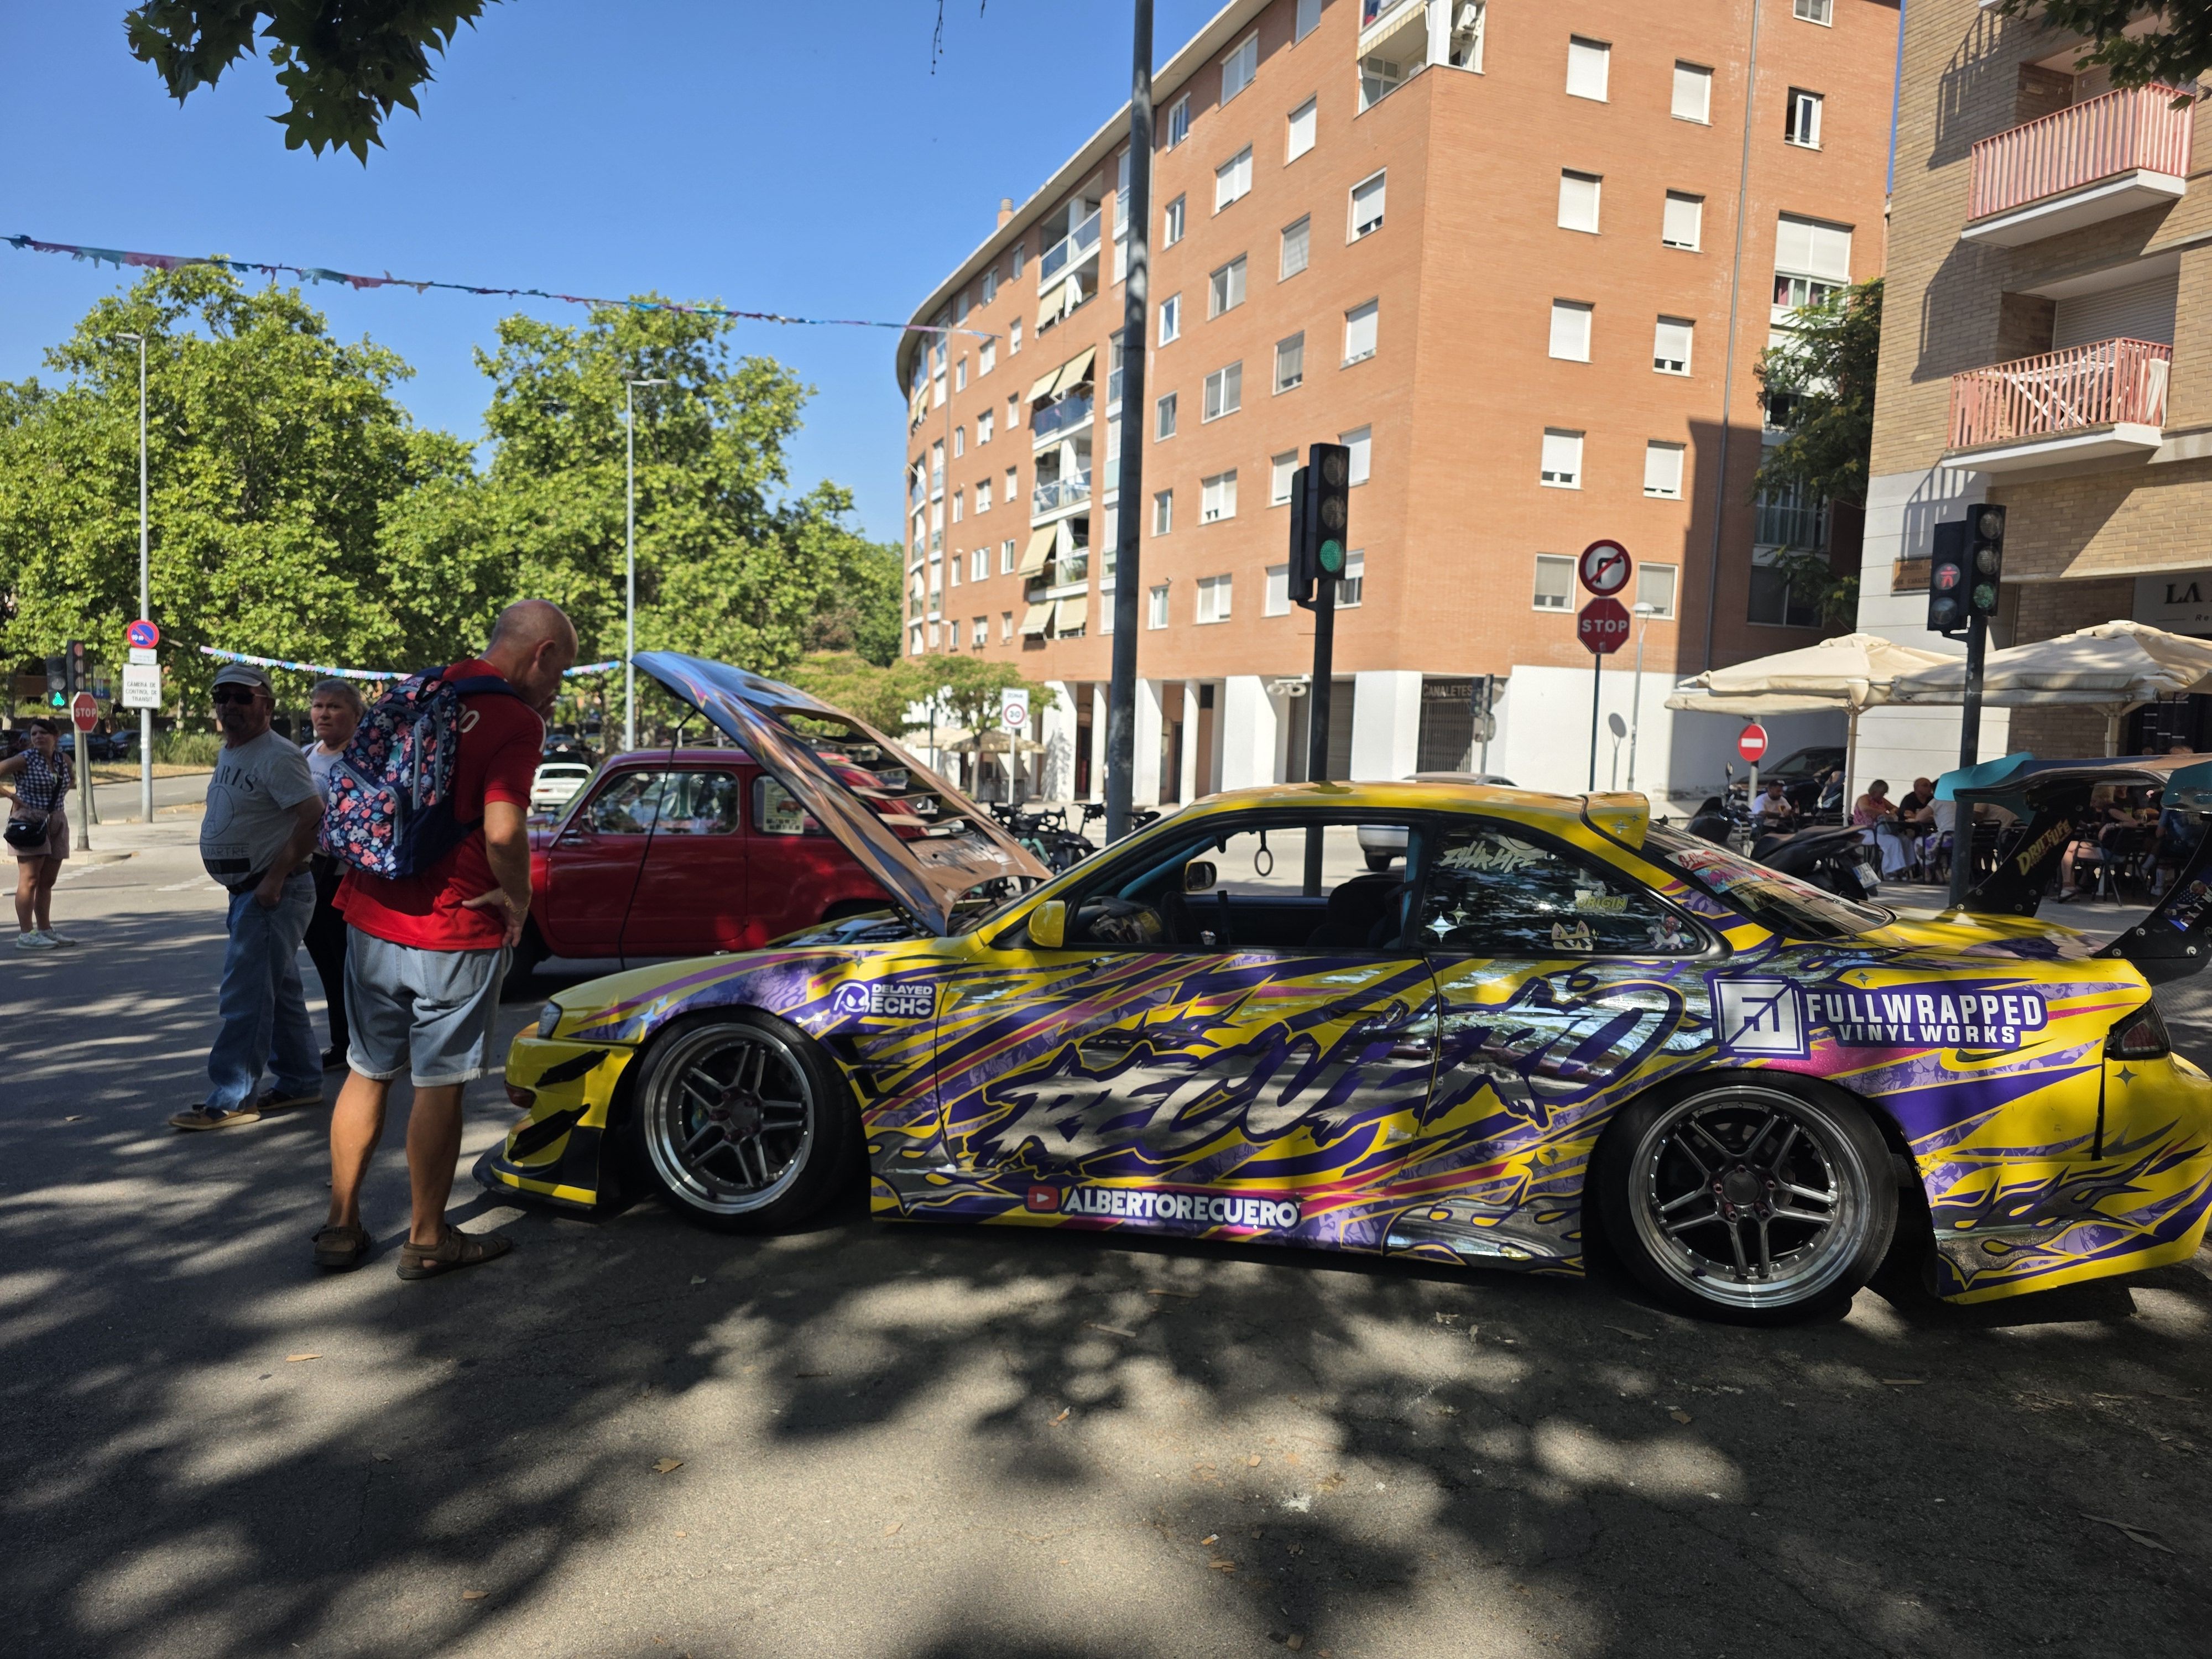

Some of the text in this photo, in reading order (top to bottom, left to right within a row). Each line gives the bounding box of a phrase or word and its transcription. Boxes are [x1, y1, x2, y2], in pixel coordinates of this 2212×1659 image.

[2164, 582, 2203, 604] LA
[1582, 619, 1628, 633] STOP
[1423, 684, 1473, 697] CANALETES
[75, 708, 96, 717] STOP
[1575, 896, 1627, 909] ORIGIN
[872, 984, 933, 995] DELAYED
[870, 997, 932, 1015] ECHO
[1807, 994, 2042, 1025] FULLWRAPPED
[1065, 1189, 1297, 1228] ALBERTORECUERO
